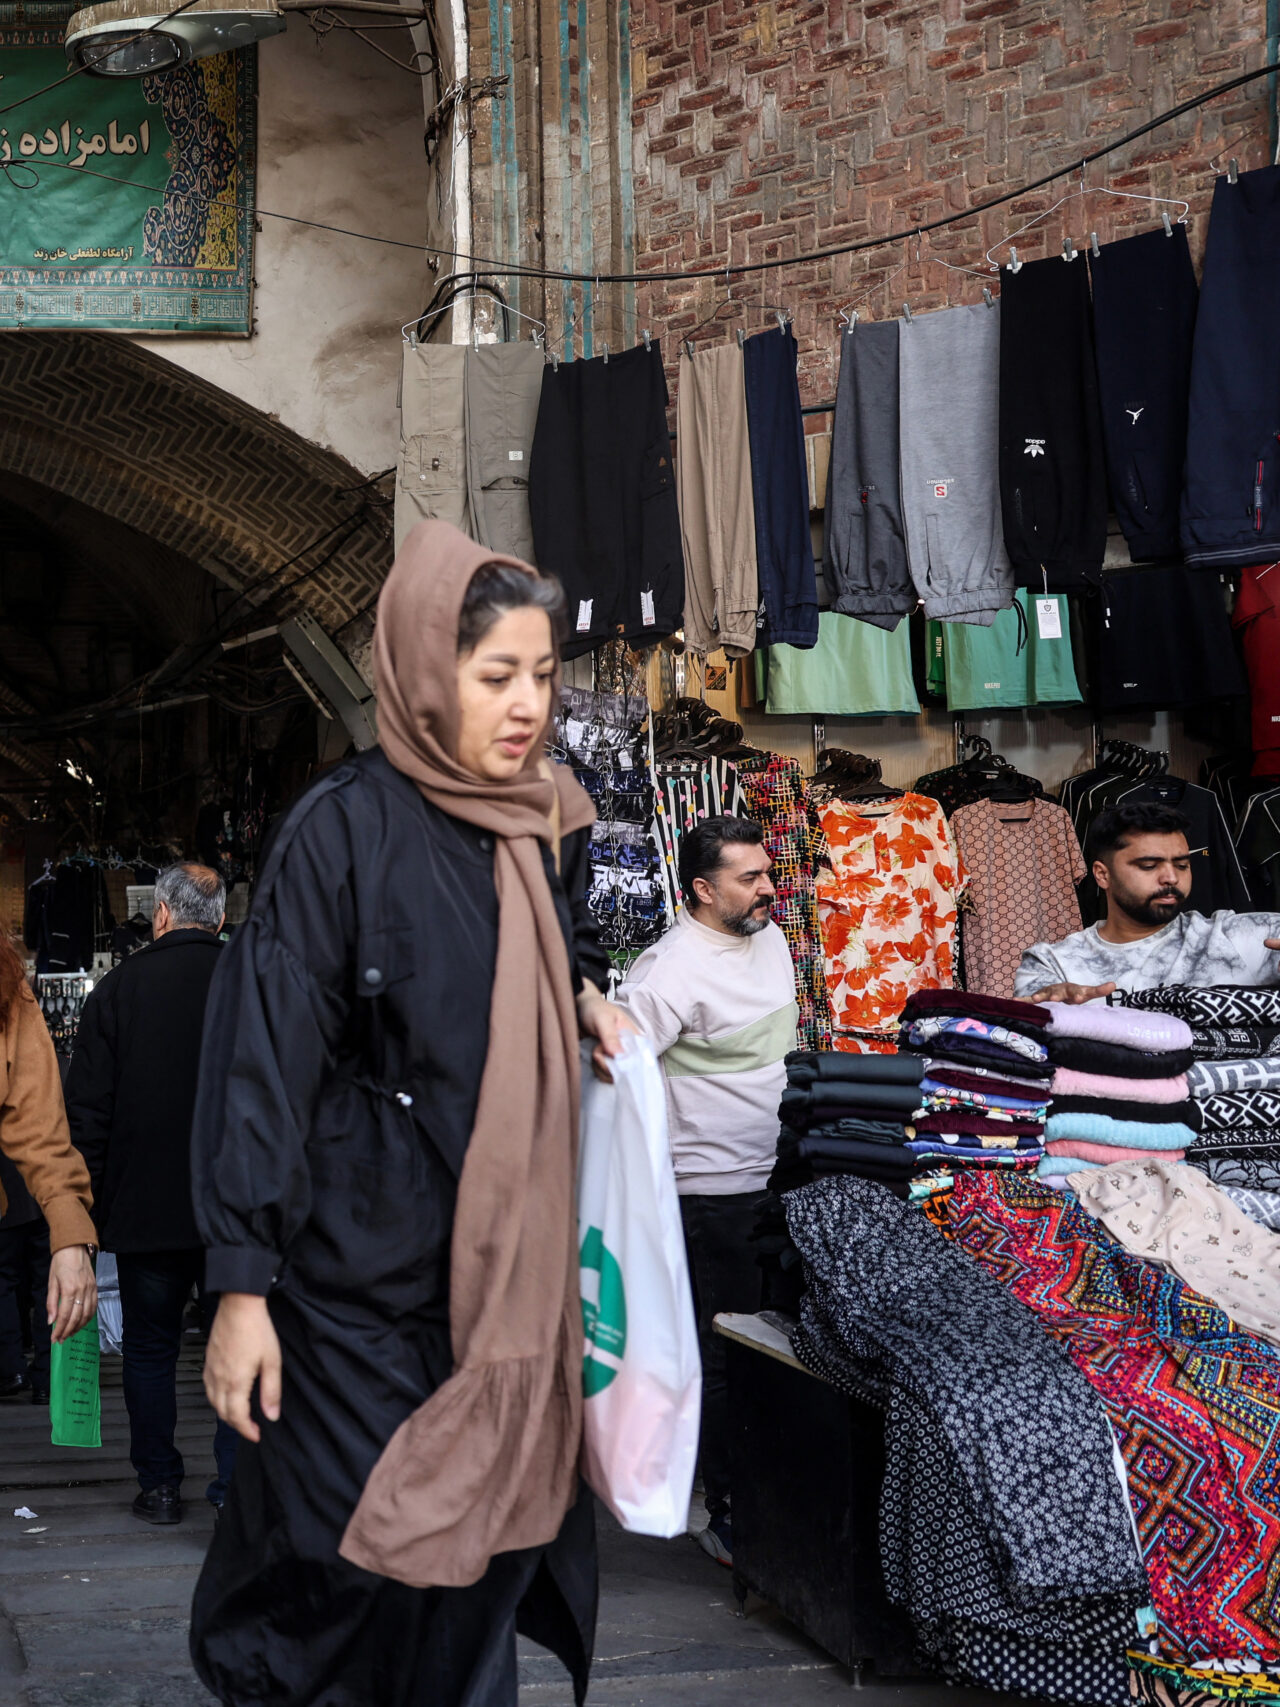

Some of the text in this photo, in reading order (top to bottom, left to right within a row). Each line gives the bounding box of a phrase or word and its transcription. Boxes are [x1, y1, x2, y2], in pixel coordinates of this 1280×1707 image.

[19, 119, 151, 167] امامزاده
[33, 247, 48, 261] زند
[49, 247, 68, 261] خان
